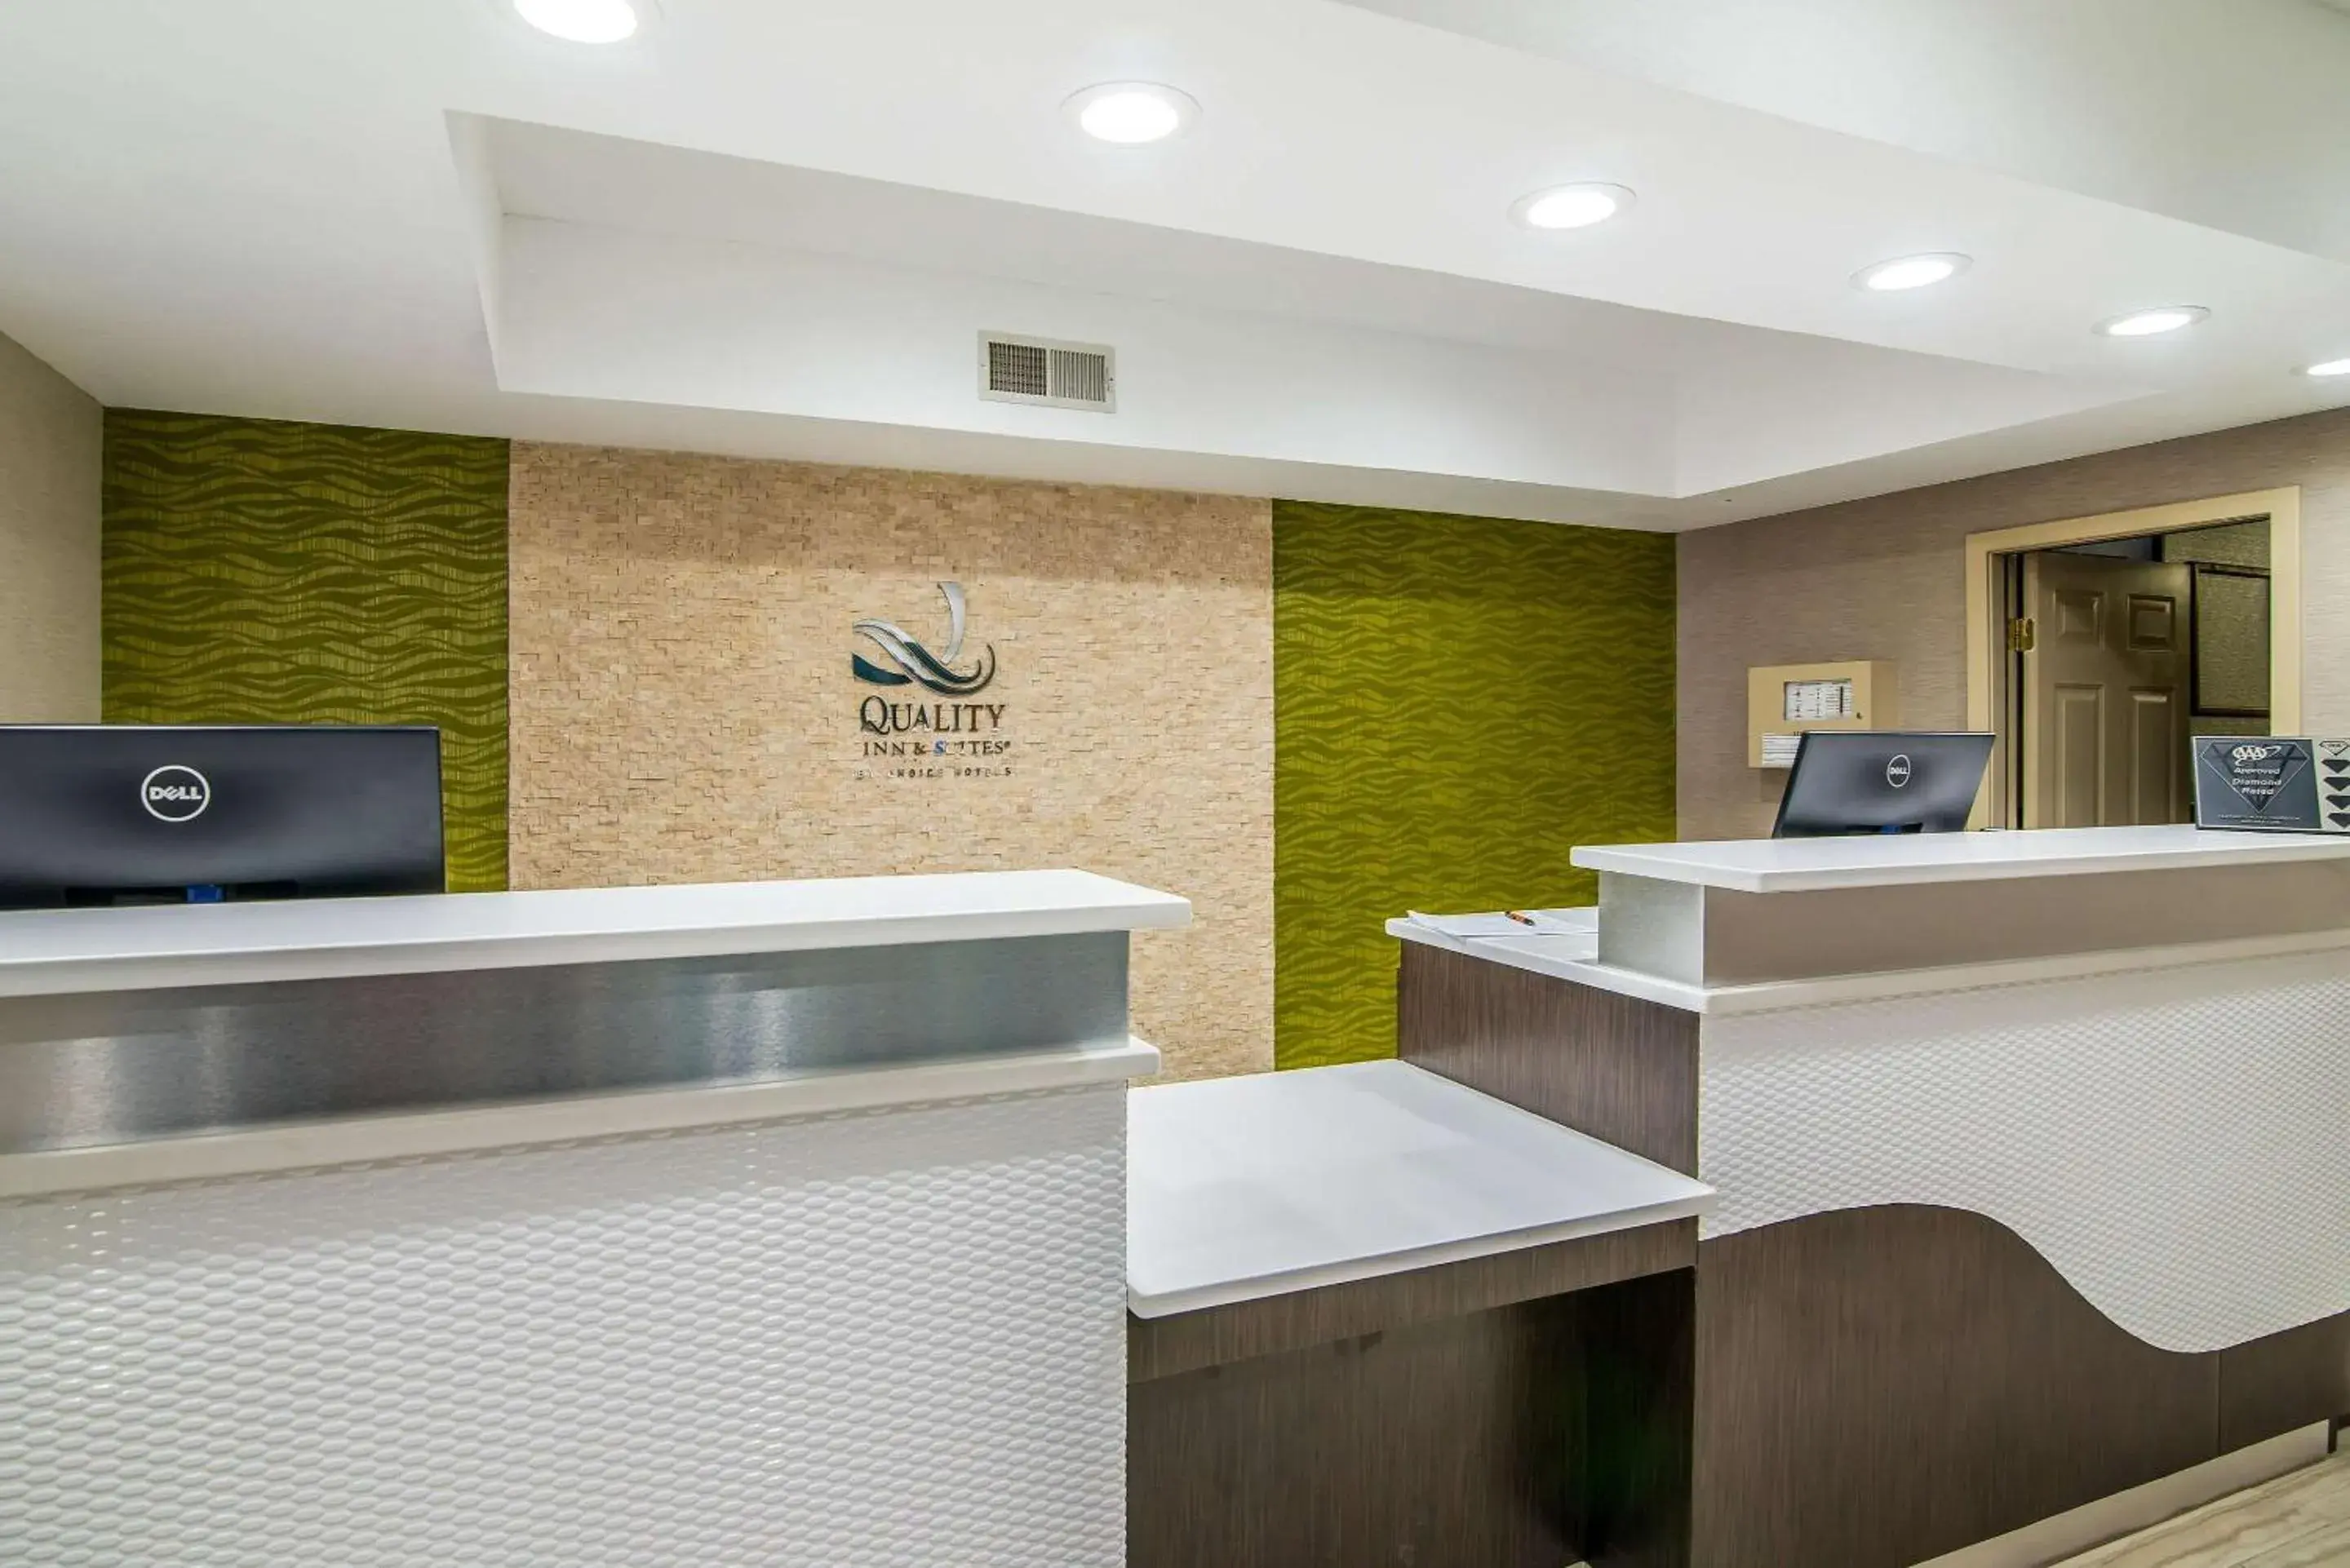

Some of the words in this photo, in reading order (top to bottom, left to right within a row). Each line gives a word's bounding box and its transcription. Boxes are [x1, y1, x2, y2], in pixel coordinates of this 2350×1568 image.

[860, 695, 1005, 735] QUALITY
[863, 741, 905, 756] INN
[913, 741, 927, 755] &
[2233, 768, 2281, 776] Approved
[2232, 778, 2282, 786] Diamond
[149, 786, 202, 800] DELL
